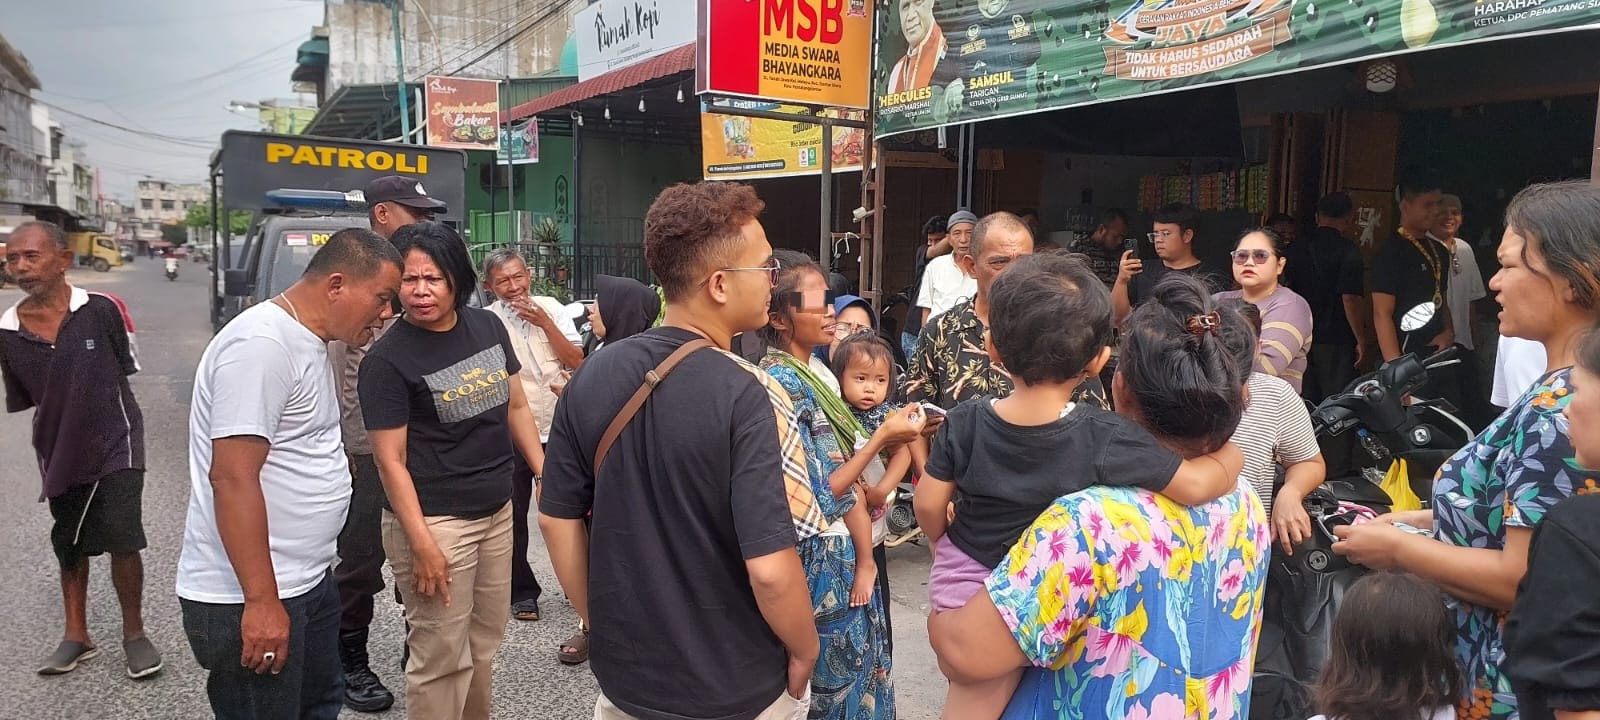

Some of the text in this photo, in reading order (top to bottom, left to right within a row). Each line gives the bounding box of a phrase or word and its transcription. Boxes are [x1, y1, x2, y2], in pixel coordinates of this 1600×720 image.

[635, 0, 661, 39] Kopi
[764, 0, 843, 44] MSB
[1187, 4, 1218, 18] INDONESIA
[1474, 16, 1505, 27] KETUA
[1508, 11, 1528, 22] DPC
[1530, 1, 1584, 18] PEMATANG
[1153, 11, 1227, 43] JAYA
[765, 41, 840, 64] MEDIA SWARA
[1126, 27, 1263, 64] TIDAK HARUS SEDARAH
[763, 59, 842, 81] BHAYANGKARA
[1131, 46, 1254, 78] UNTUK BERSAUDARA
[969, 71, 1014, 89] SAMSUL
[969, 86, 999, 98] TARIGAN
[969, 99, 985, 107] KETUA
[454, 114, 491, 126] Bakar
[267, 143, 428, 174] PATROLI
